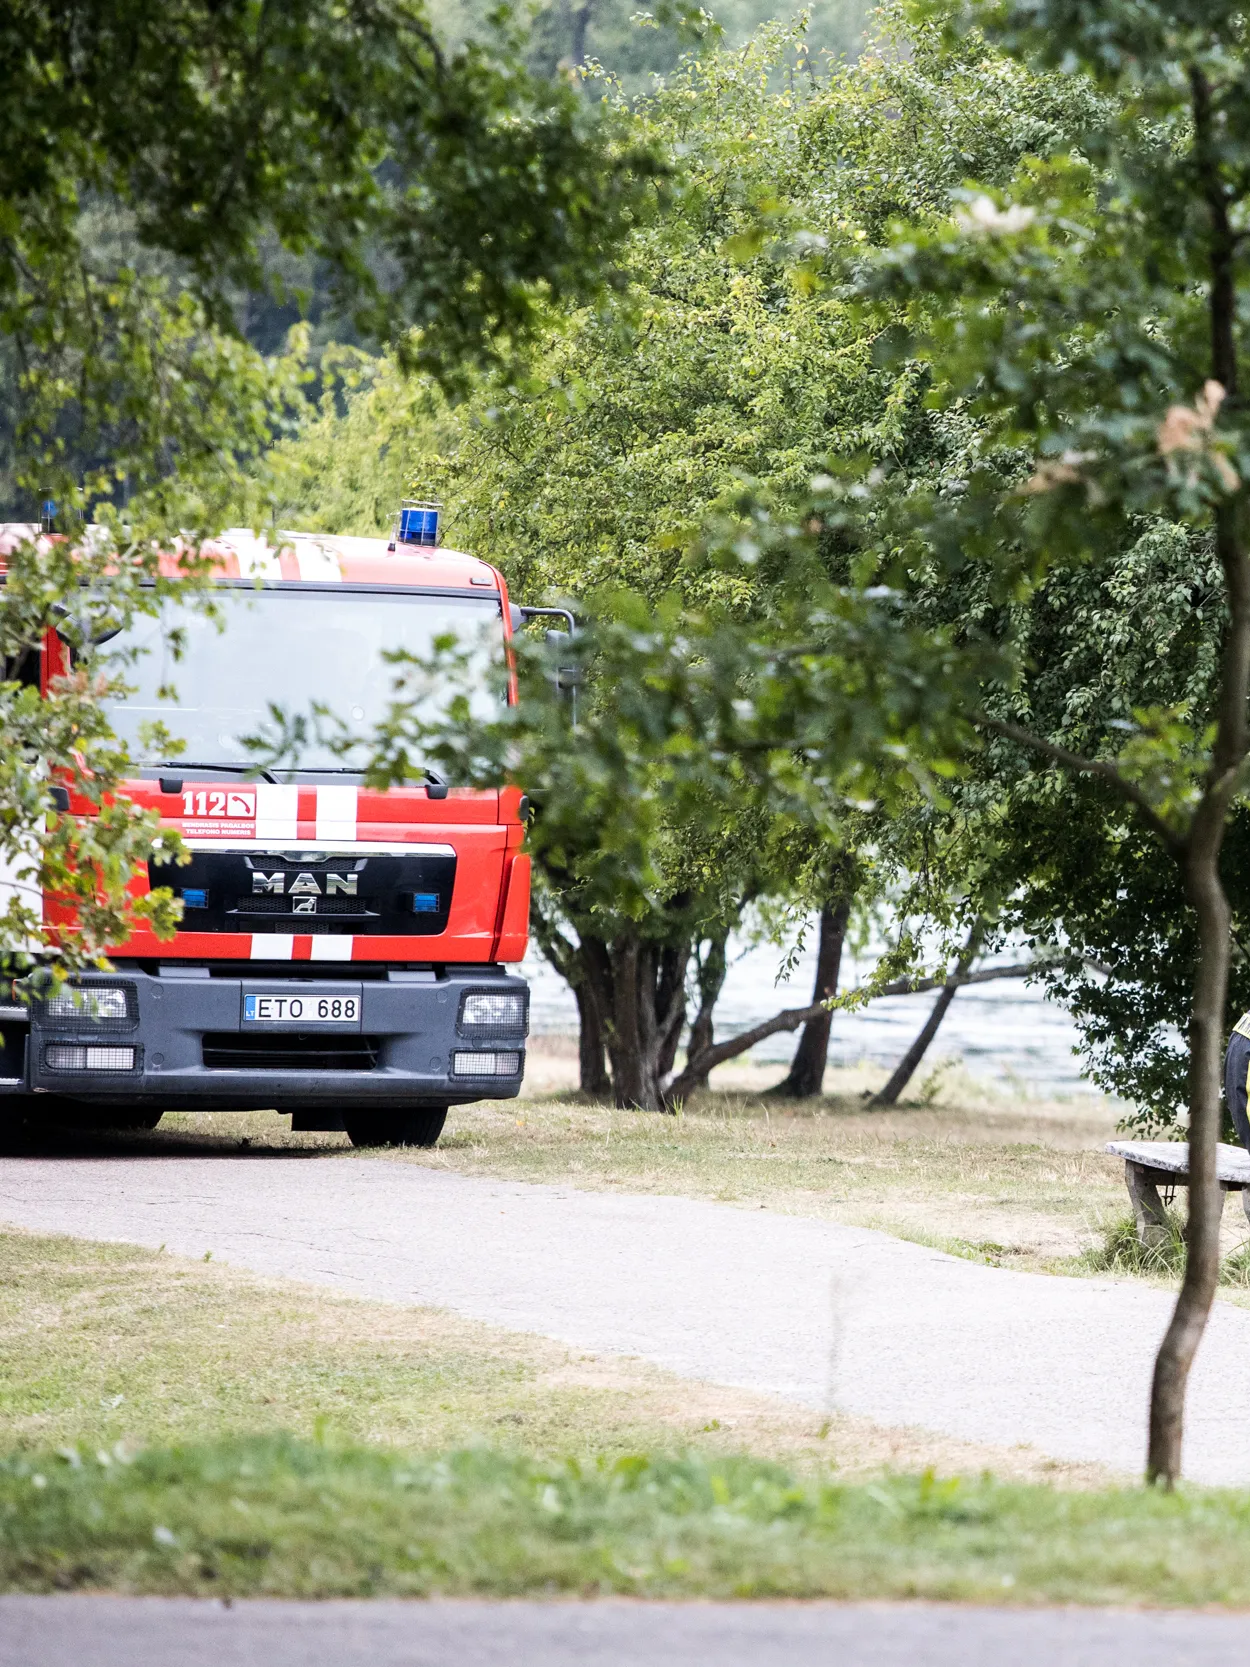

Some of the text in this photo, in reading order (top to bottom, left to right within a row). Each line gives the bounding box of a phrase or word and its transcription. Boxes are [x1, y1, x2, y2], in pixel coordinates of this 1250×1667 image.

[182, 791, 226, 816] 112
[252, 872, 358, 895] MAN
[258, 999, 303, 1018] ETO
[318, 999, 355, 1018] 688
